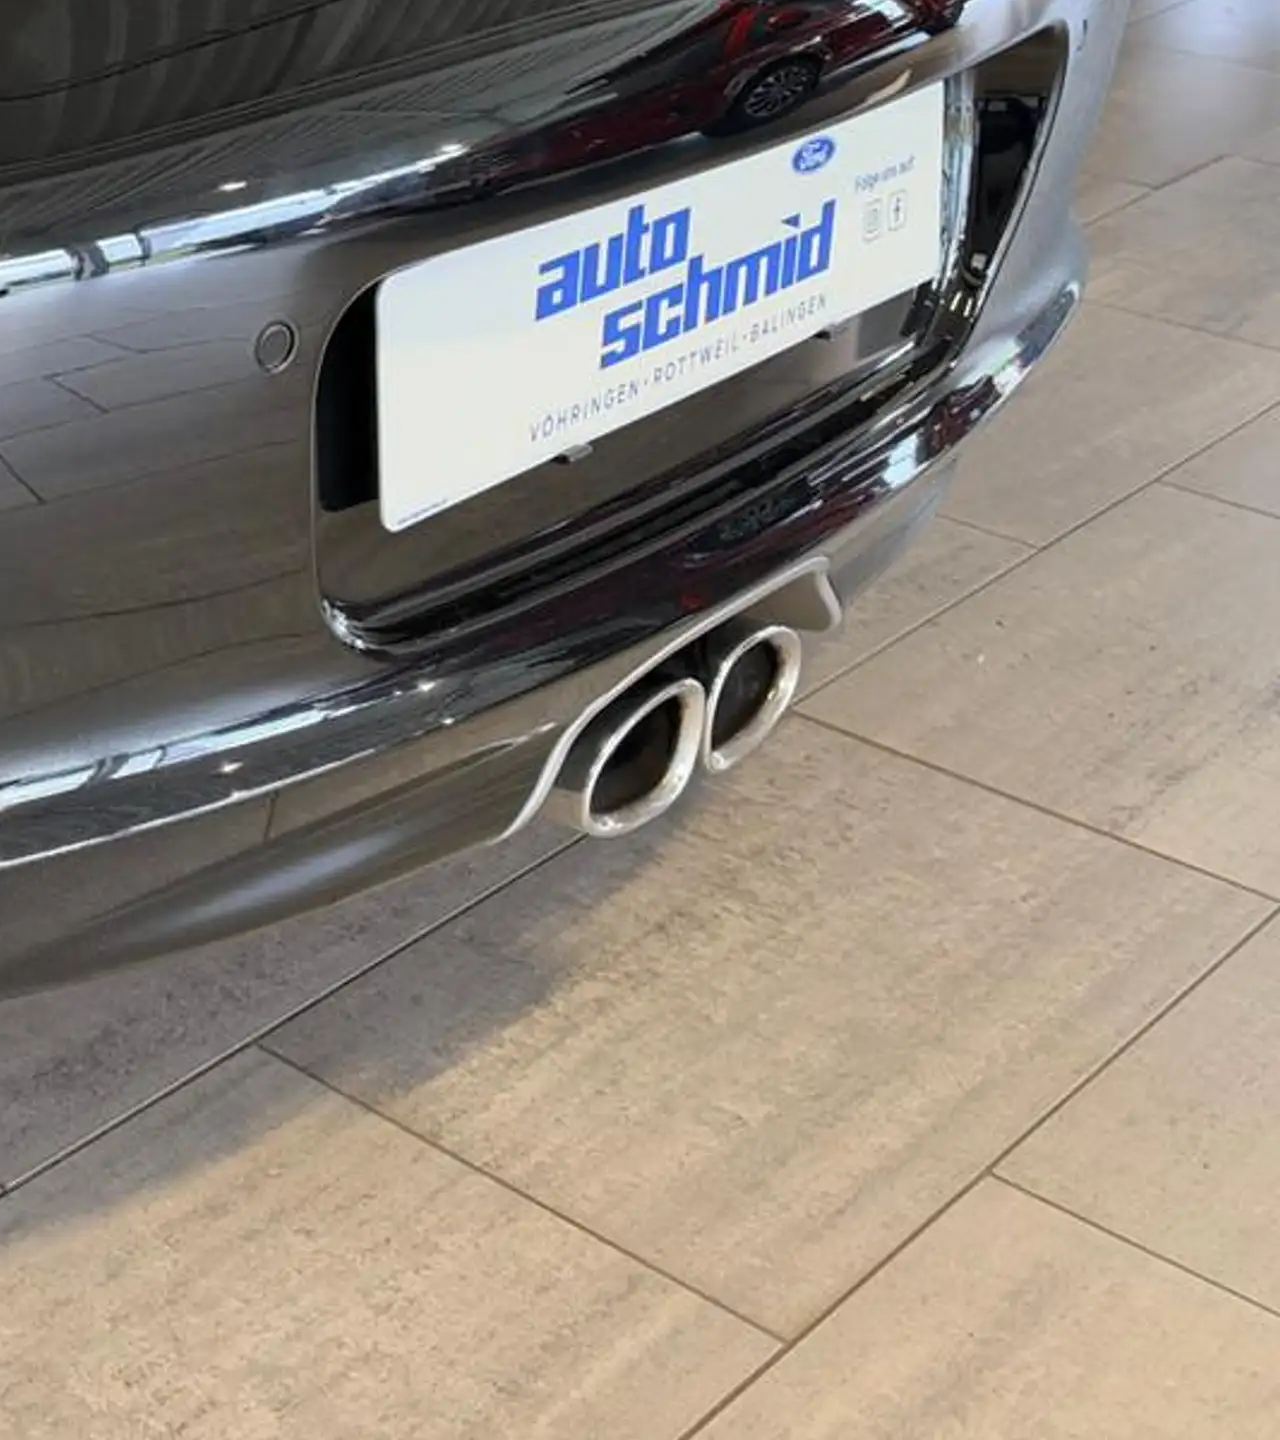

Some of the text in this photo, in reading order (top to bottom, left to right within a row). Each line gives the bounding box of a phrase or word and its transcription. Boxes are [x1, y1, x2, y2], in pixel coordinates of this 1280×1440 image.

[535, 204, 691, 321] auto
[600, 199, 836, 369] schmid
[653, 338, 740, 385] ROTTWEIL
